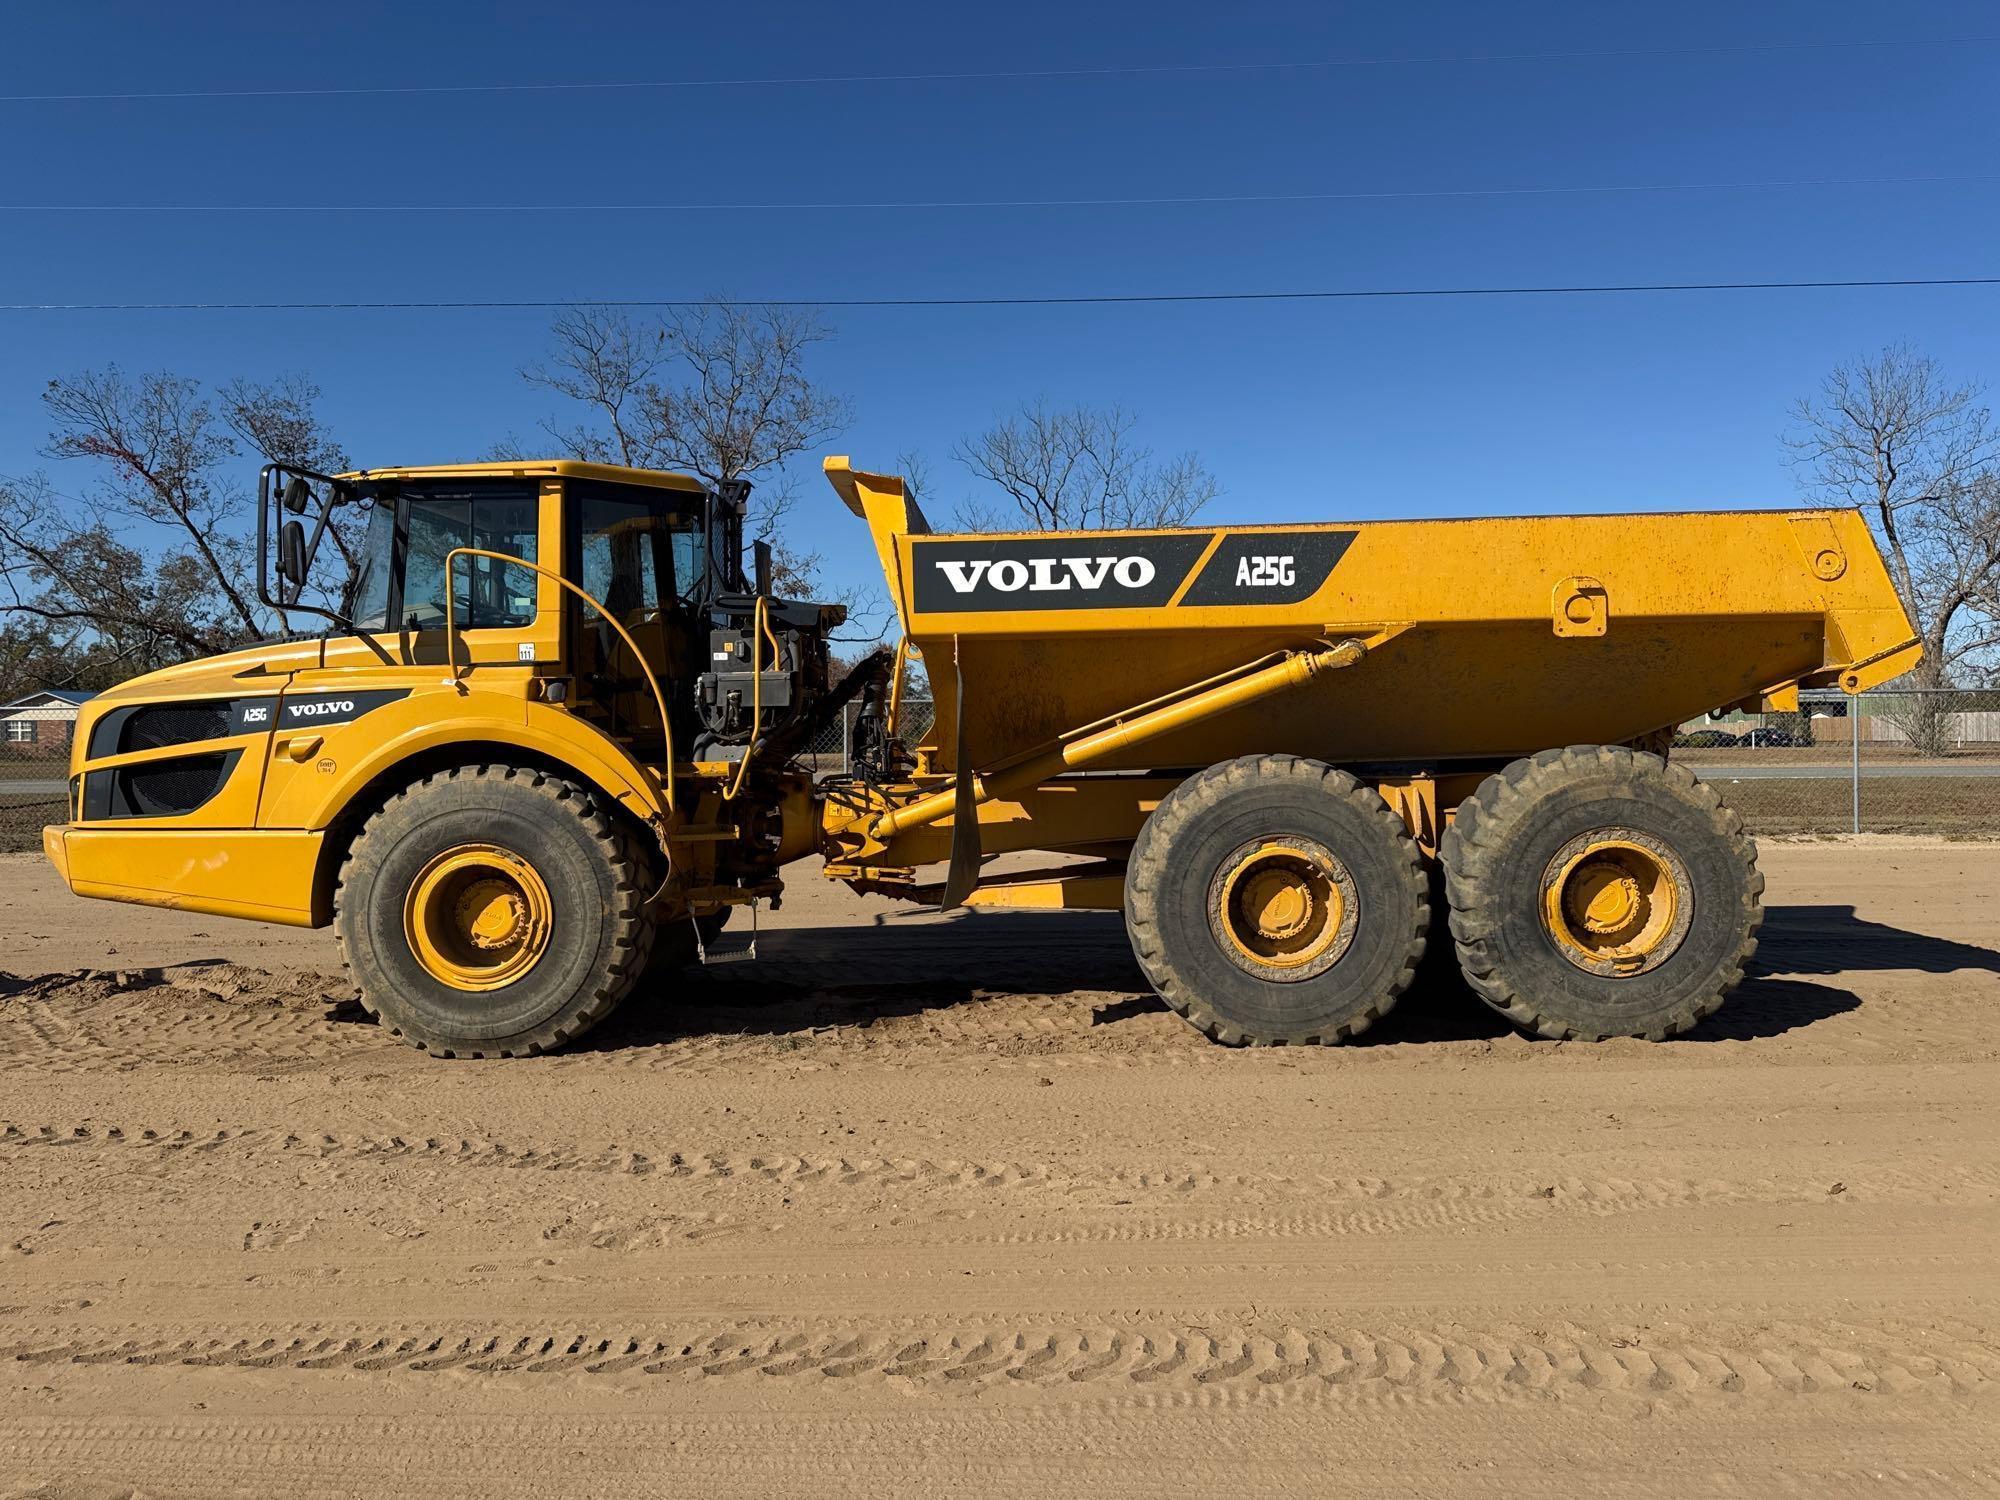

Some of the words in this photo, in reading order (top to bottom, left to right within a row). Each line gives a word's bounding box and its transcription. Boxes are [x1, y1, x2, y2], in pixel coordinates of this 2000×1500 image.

[936, 556, 1156, 593] VOLVO
[1235, 555, 1296, 587] A25G
[243, 707, 267, 723] A25G
[288, 700, 355, 717] VOLVO
